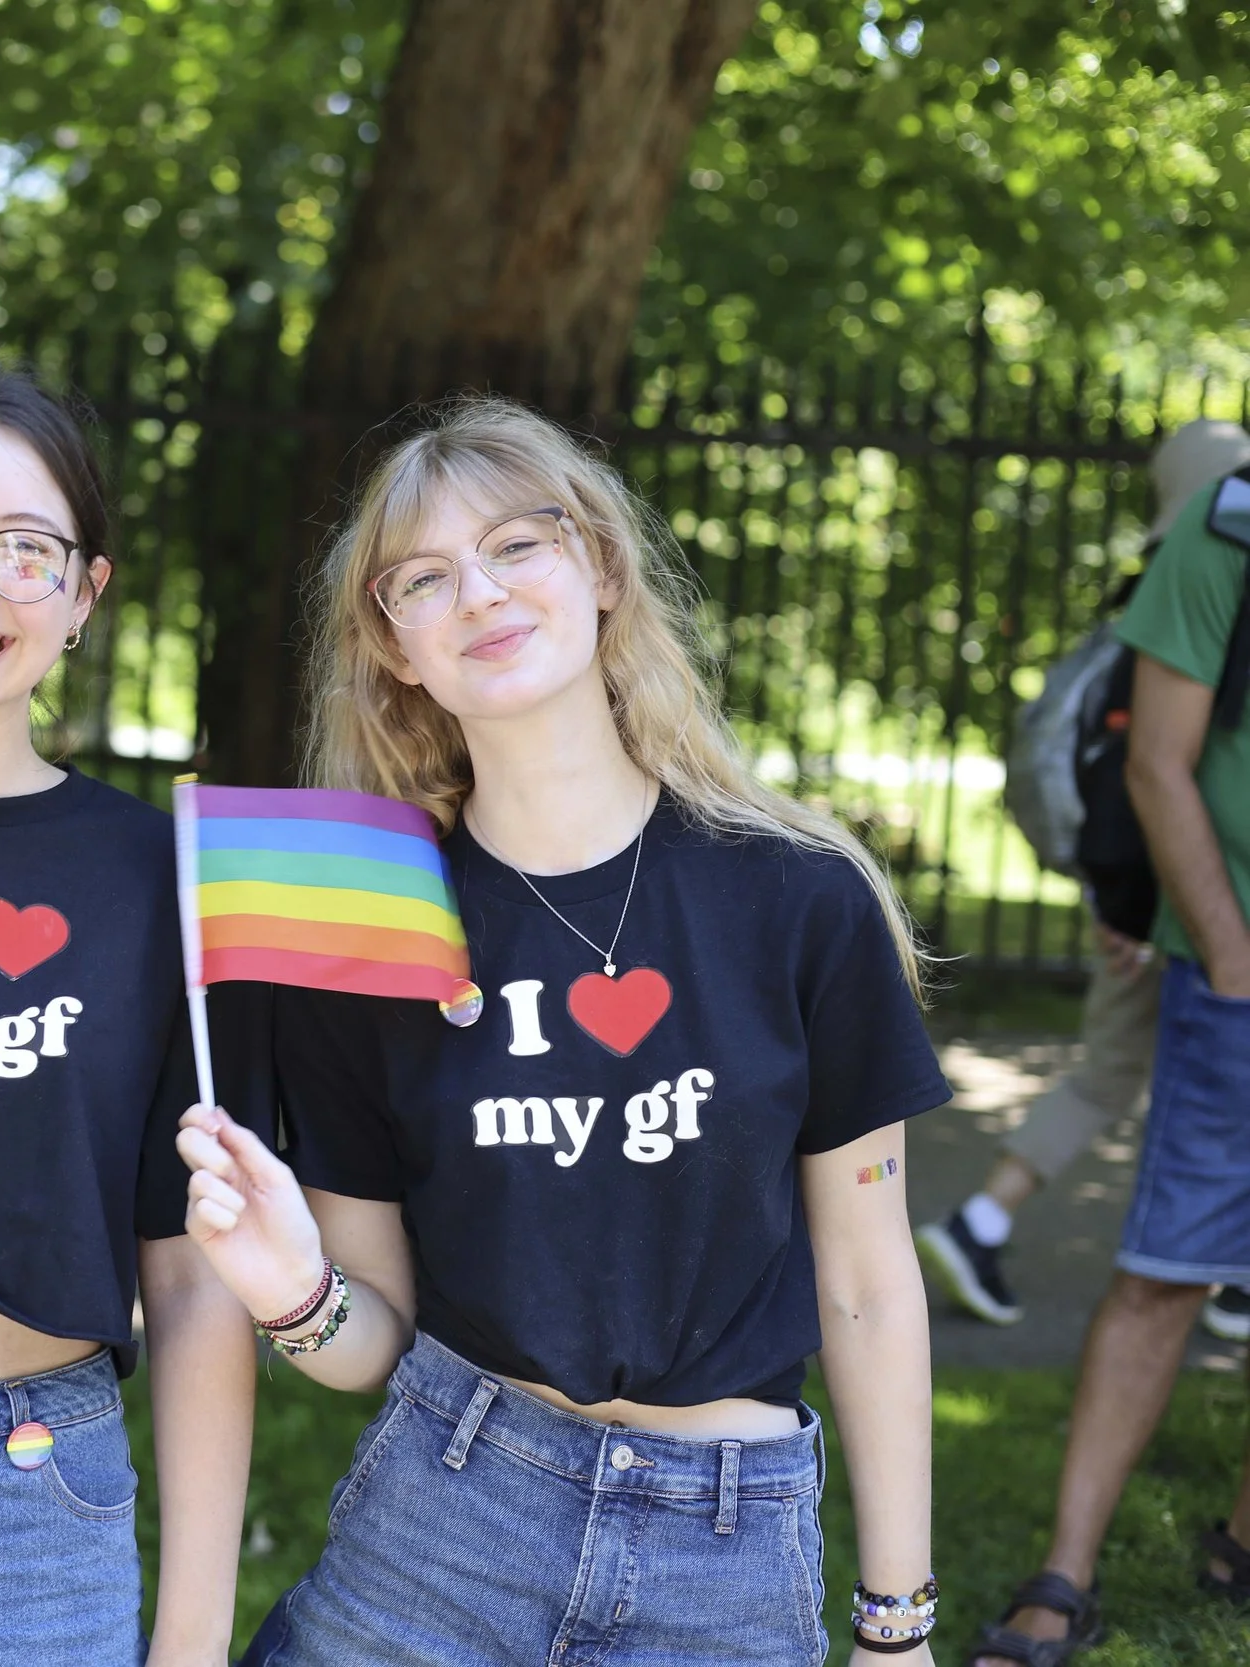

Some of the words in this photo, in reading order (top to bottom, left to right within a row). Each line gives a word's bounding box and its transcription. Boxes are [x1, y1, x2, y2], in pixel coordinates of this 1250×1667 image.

[500, 980, 552, 1057] I
[473, 1097, 604, 1167] my
[623, 1068, 715, 1163] gf
